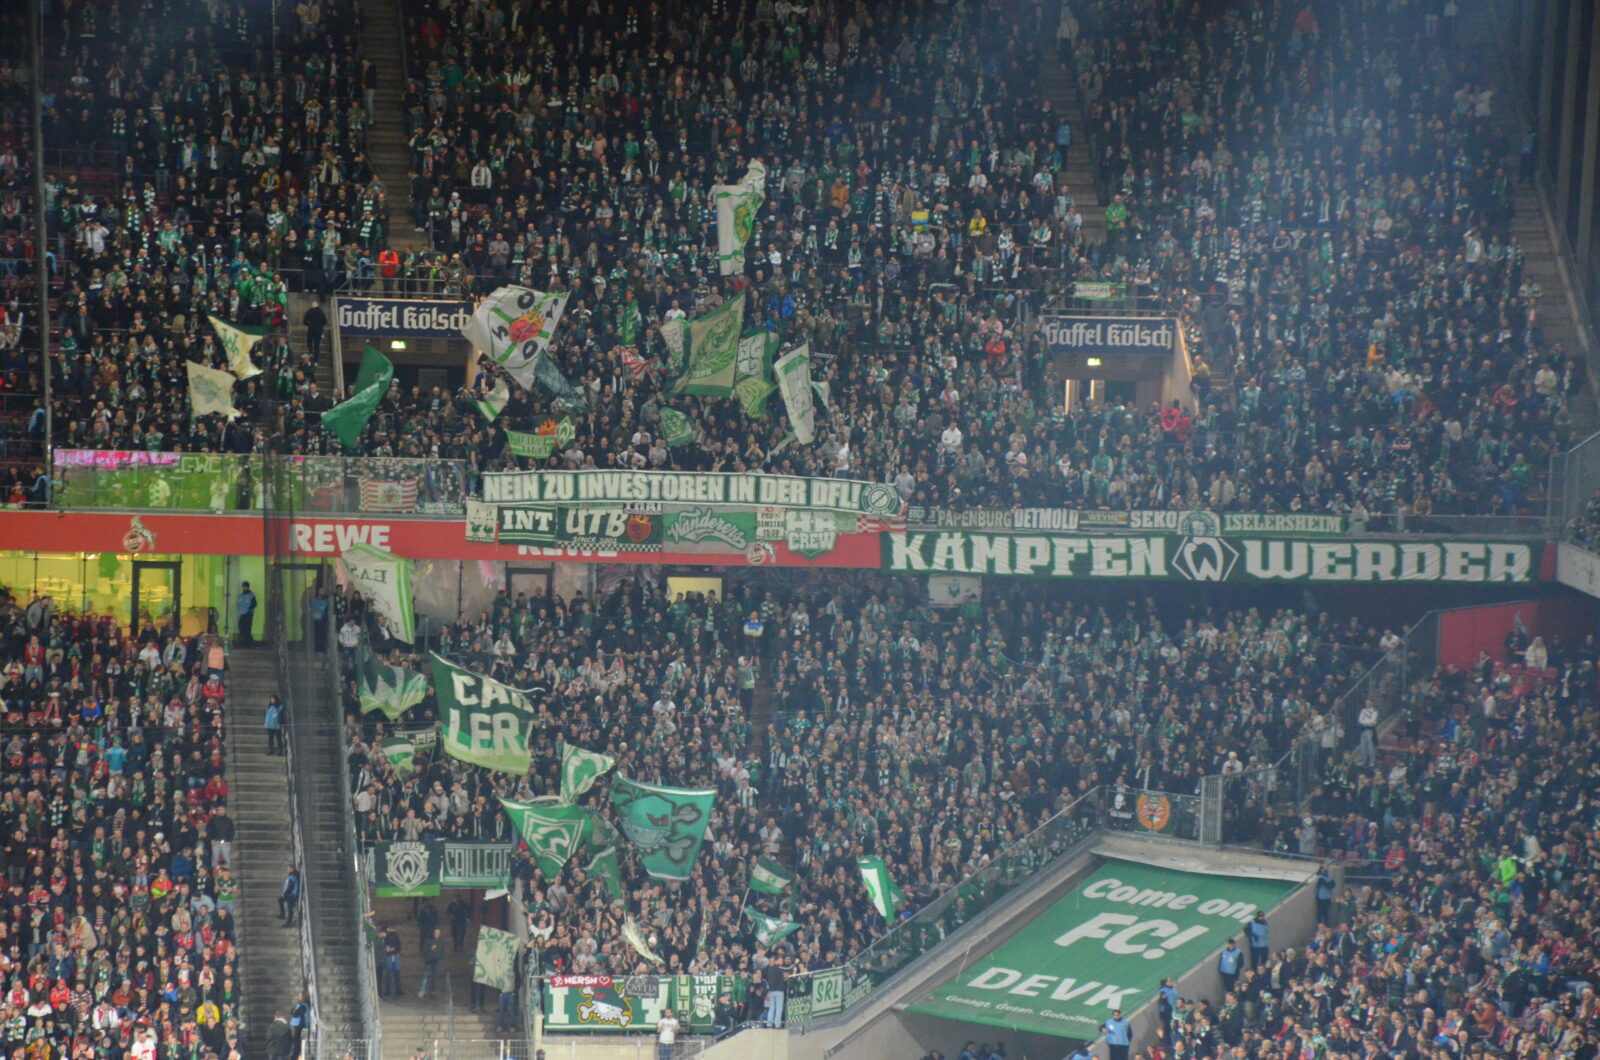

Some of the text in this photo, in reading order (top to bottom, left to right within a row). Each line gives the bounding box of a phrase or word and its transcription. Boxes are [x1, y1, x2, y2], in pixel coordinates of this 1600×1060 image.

[339, 302, 400, 330] Gaffel
[1107, 323, 1173, 350] Kölsch
[484, 474, 539, 500] NEIN
[543, 474, 574, 500] ZU
[579, 473, 724, 502] INVESTOREN
[729, 475, 756, 502] IN
[760, 477, 806, 505] DER
[811, 479, 862, 509] DFL!
[502, 509, 553, 531] INT
[566, 508, 628, 537] UTB
[667, 507, 745, 543] Wanderers
[937, 511, 1012, 528] PAPENBURG
[1014, 507, 1079, 530] DETMOLD
[1224, 513, 1341, 533] ISELERSHEIM
[289, 523, 391, 552] REWE
[788, 532, 836, 550] CREW
[889, 530, 1168, 577] KÄMPFEN
[1242, 539, 1530, 584] WERDER
[1082, 877, 1200, 911] Come
[1053, 912, 1210, 960] FC!
[565, 976, 598, 985] HERSH
[967, 966, 1145, 1010] DEVK
